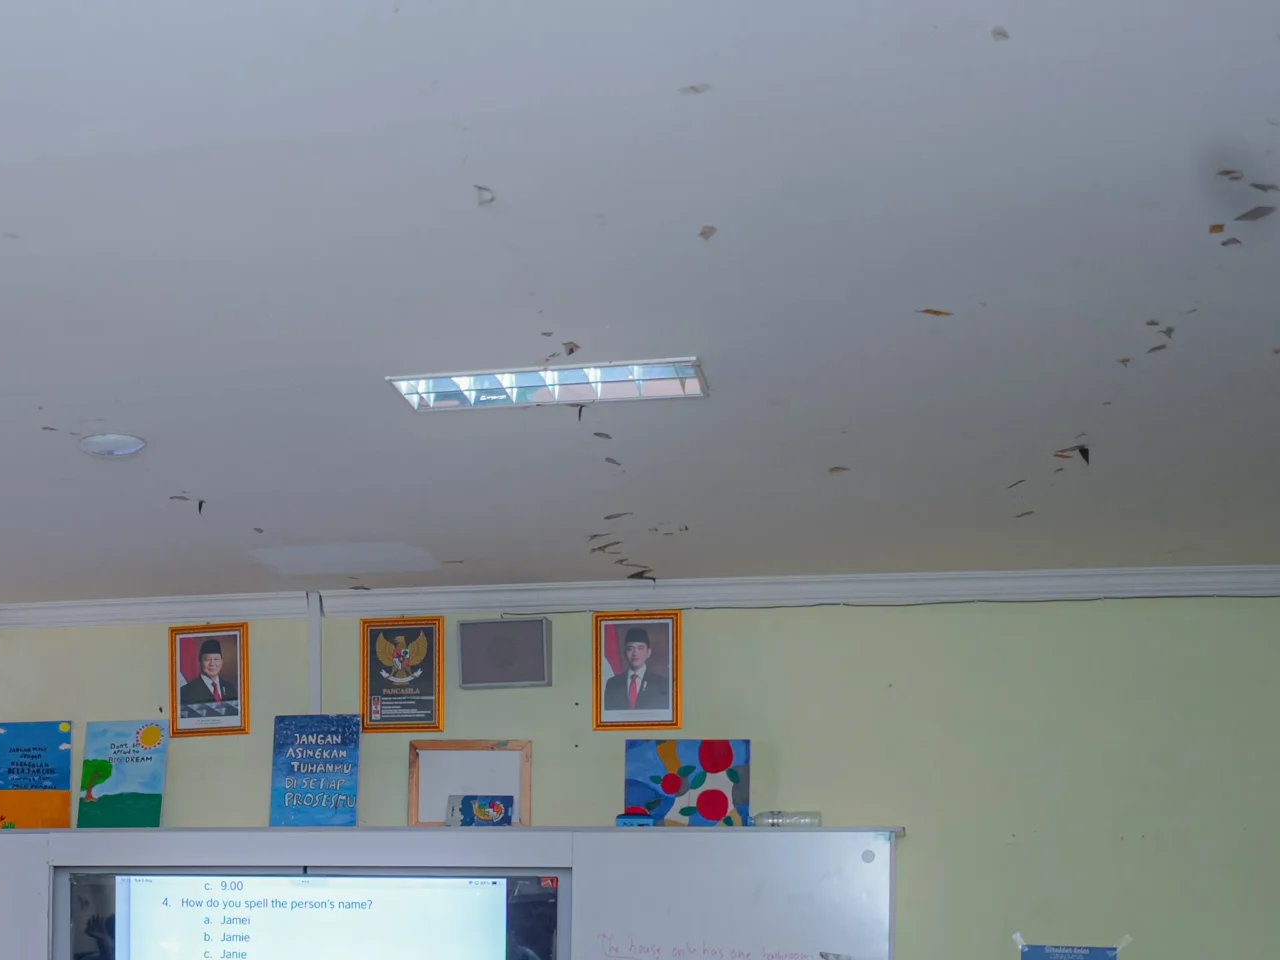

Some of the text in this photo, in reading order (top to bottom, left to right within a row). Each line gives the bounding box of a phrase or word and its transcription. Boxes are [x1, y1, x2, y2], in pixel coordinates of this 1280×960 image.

[294, 733, 341, 745] JANGAN
[286, 747, 347, 759] ASINGKAN
[108, 756, 122, 764] BIG
[291, 761, 351, 773] TUHANMU
[285, 777, 345, 790] DI SETIAP
[284, 792, 356, 809] PROSESMU
[204, 881, 244, 891] c. 9.00
[162, 897, 373, 911] 4. How do you spell the person's name?
[204, 916, 251, 925] a. Jamei
[204, 932, 251, 942] b. Jamie
[597, 932, 620, 954] The
[702, 942, 724, 959] has
[730, 948, 752, 960] one
[204, 949, 247, 959] c. Janie
